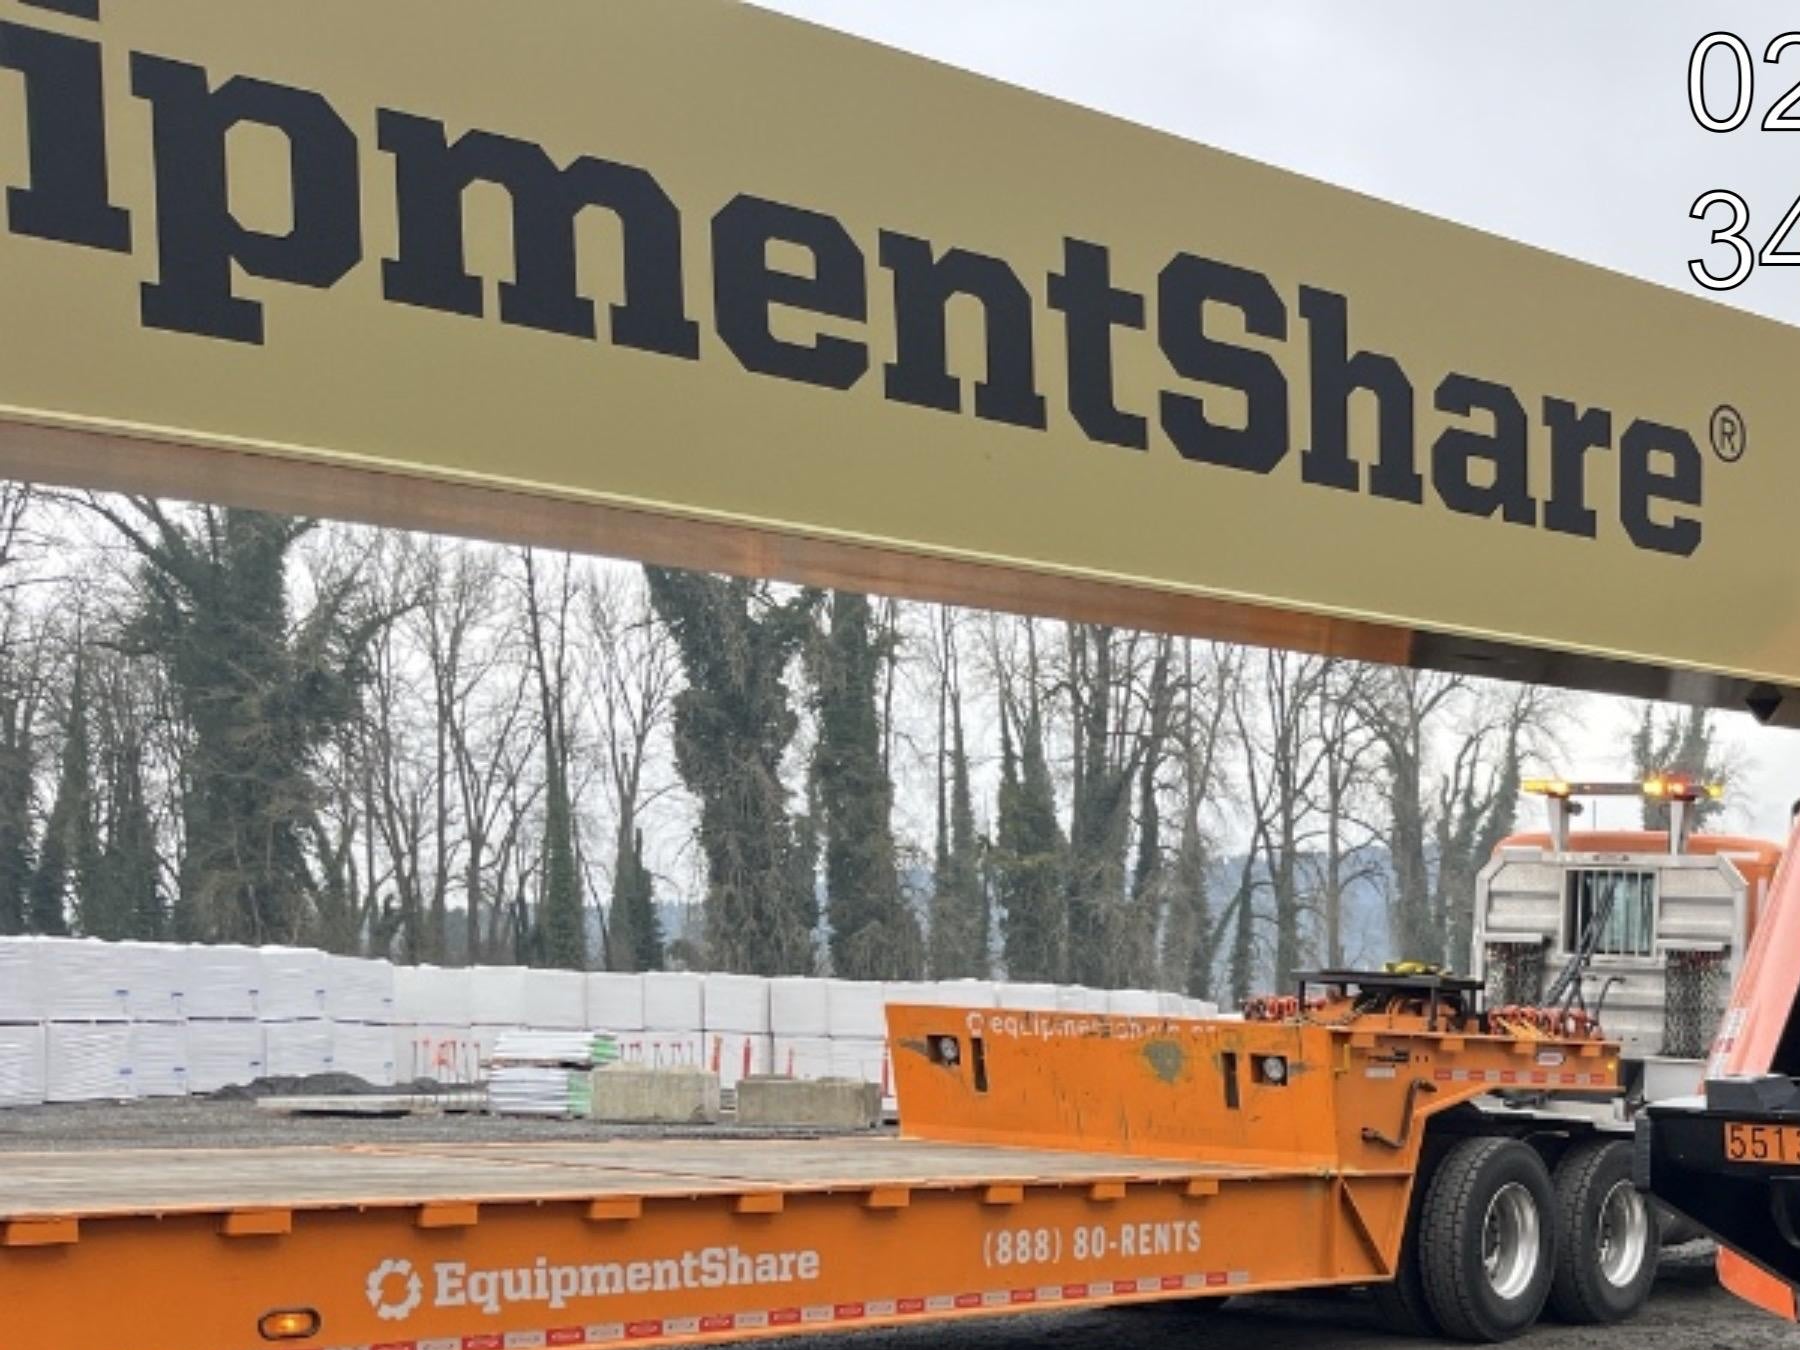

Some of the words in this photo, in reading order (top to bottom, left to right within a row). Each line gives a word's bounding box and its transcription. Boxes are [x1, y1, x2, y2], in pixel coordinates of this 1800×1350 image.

[984, 1226, 1063, 1268] (888)
[1072, 1219, 1202, 1261] 80-RENTS
[433, 1245, 821, 1314] EquipmentShare
